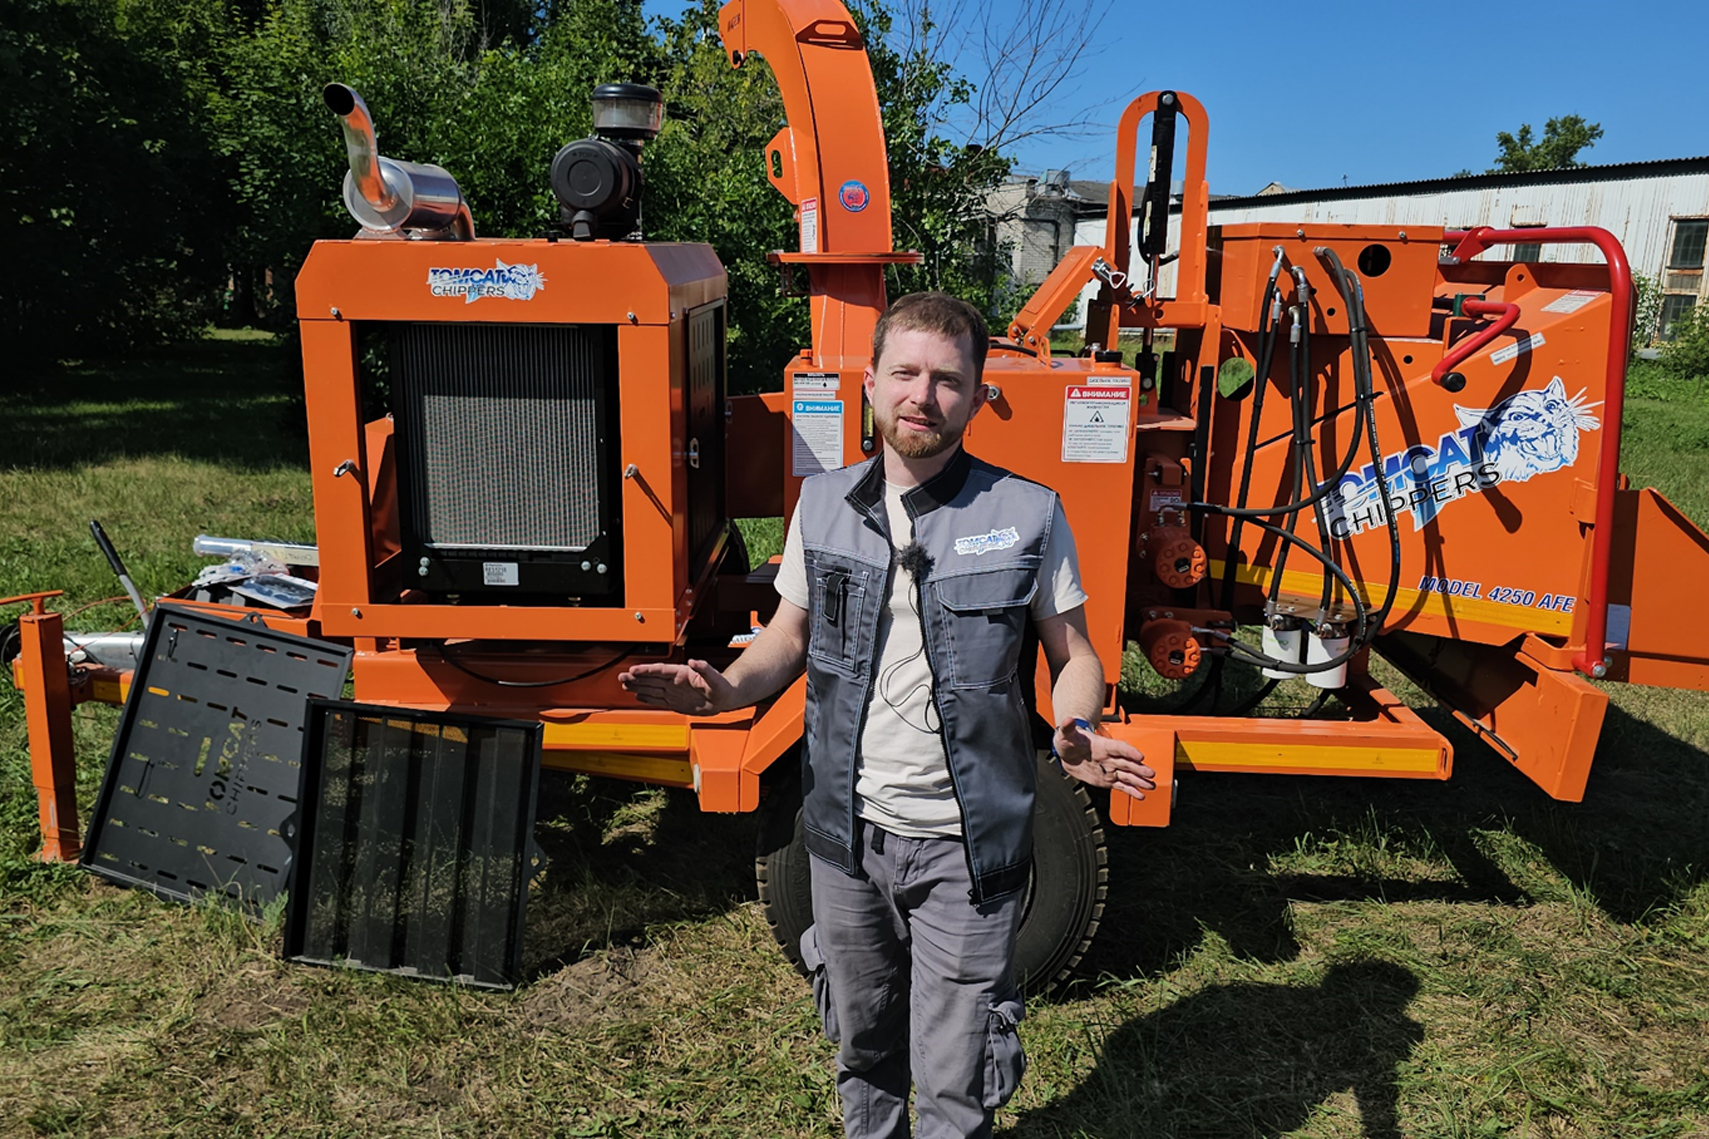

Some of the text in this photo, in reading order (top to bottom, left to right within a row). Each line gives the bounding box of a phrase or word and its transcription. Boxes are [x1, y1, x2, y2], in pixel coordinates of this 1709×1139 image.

[431, 269, 504, 284] TOMCAT
[432, 285, 505, 296] CHIPPERS
[1082, 390, 1127, 399] ВНИМАНИЕ
[1330, 462, 1502, 538] CHIPPERS
[957, 534, 997, 547] TOMCAT
[1418, 575, 1577, 613] MODEL 4250 AFE
[205, 706, 248, 813] TOMCAT
